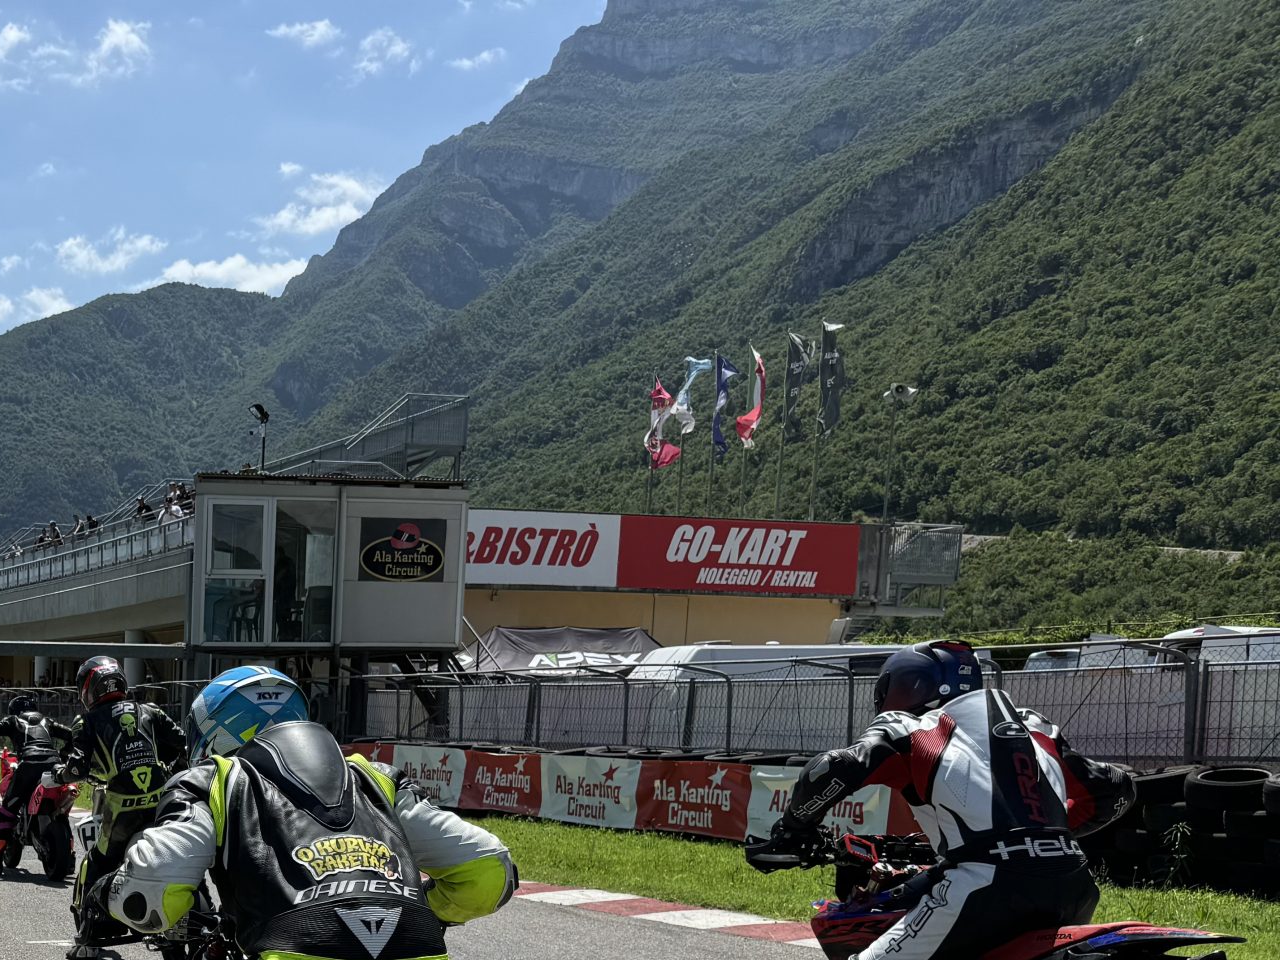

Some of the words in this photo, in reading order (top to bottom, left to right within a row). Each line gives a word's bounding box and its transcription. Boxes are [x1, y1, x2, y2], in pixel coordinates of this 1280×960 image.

[473, 523, 599, 567] BISTRÒ
[666, 524, 807, 566] GO-KART
[373, 550, 391, 562] Ala
[394, 551, 434, 566] Karting
[385, 564, 421, 576] Circuit
[696, 567, 761, 586] NOLEGGIO
[770, 570, 818, 588] RENTAL
[528, 651, 643, 668] APEX
[256, 691, 285, 700] KYT
[111, 702, 135, 718] 22
[125, 741, 144, 751] LAPS
[403, 762, 418, 779] Ala
[420, 763, 453, 786] Karting
[475, 766, 491, 784] Ala
[493, 767, 531, 793] Karting
[121, 792, 164, 808] DEA
[483, 785, 519, 808] Circuit
[555, 775, 573, 795] Ala
[577, 776, 621, 804] Karting
[653, 779, 676, 801] Ala
[680, 780, 732, 812] Karting
[568, 797, 606, 821] Circuit
[668, 802, 713, 829] Circuit
[297, 847, 315, 862] O
[315, 837, 390, 861] KURWA
[293, 879, 419, 905] DAINESE
[1035, 933, 1073, 941] HONDA
